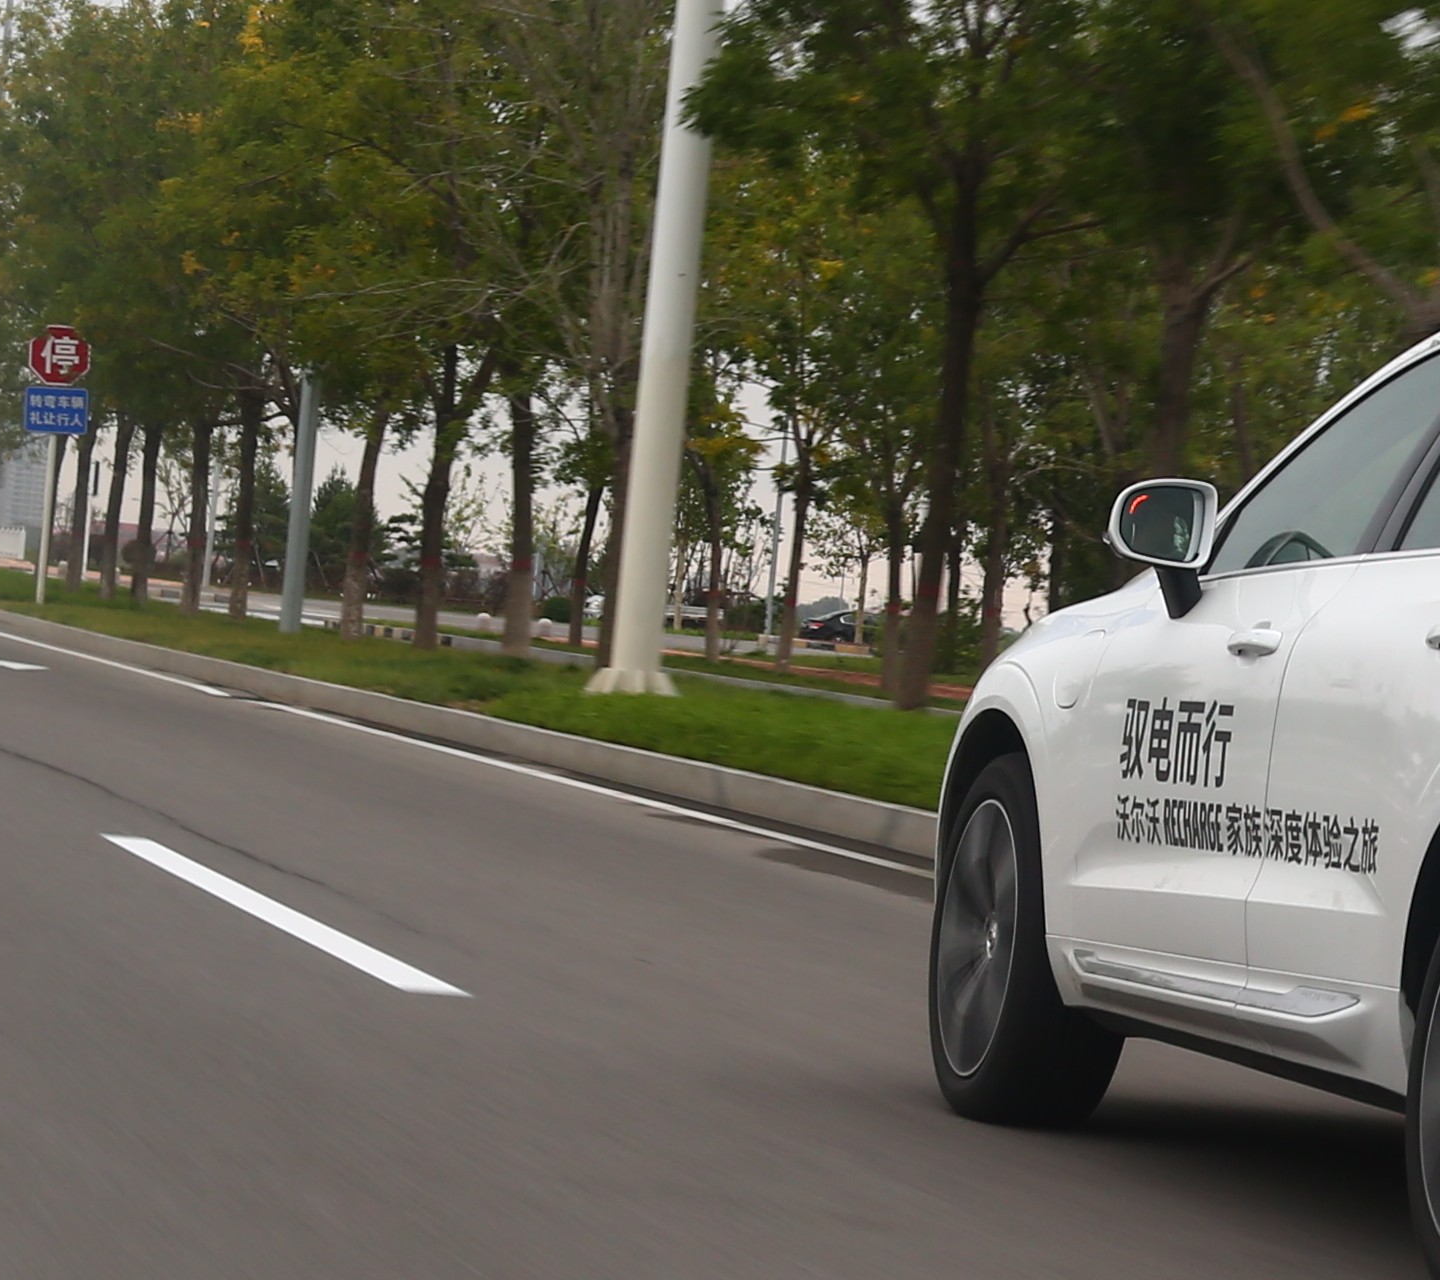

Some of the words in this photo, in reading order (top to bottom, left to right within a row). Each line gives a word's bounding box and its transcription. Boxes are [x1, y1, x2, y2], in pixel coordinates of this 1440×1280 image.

[40, 336, 80, 374] 停
[29, 394, 85, 409] 转弯车辆
[29, 412, 83, 426] 礼让行人
[1119, 697, 1235, 788] 驭电而行
[1163, 798, 1224, 853] RECHARGE
